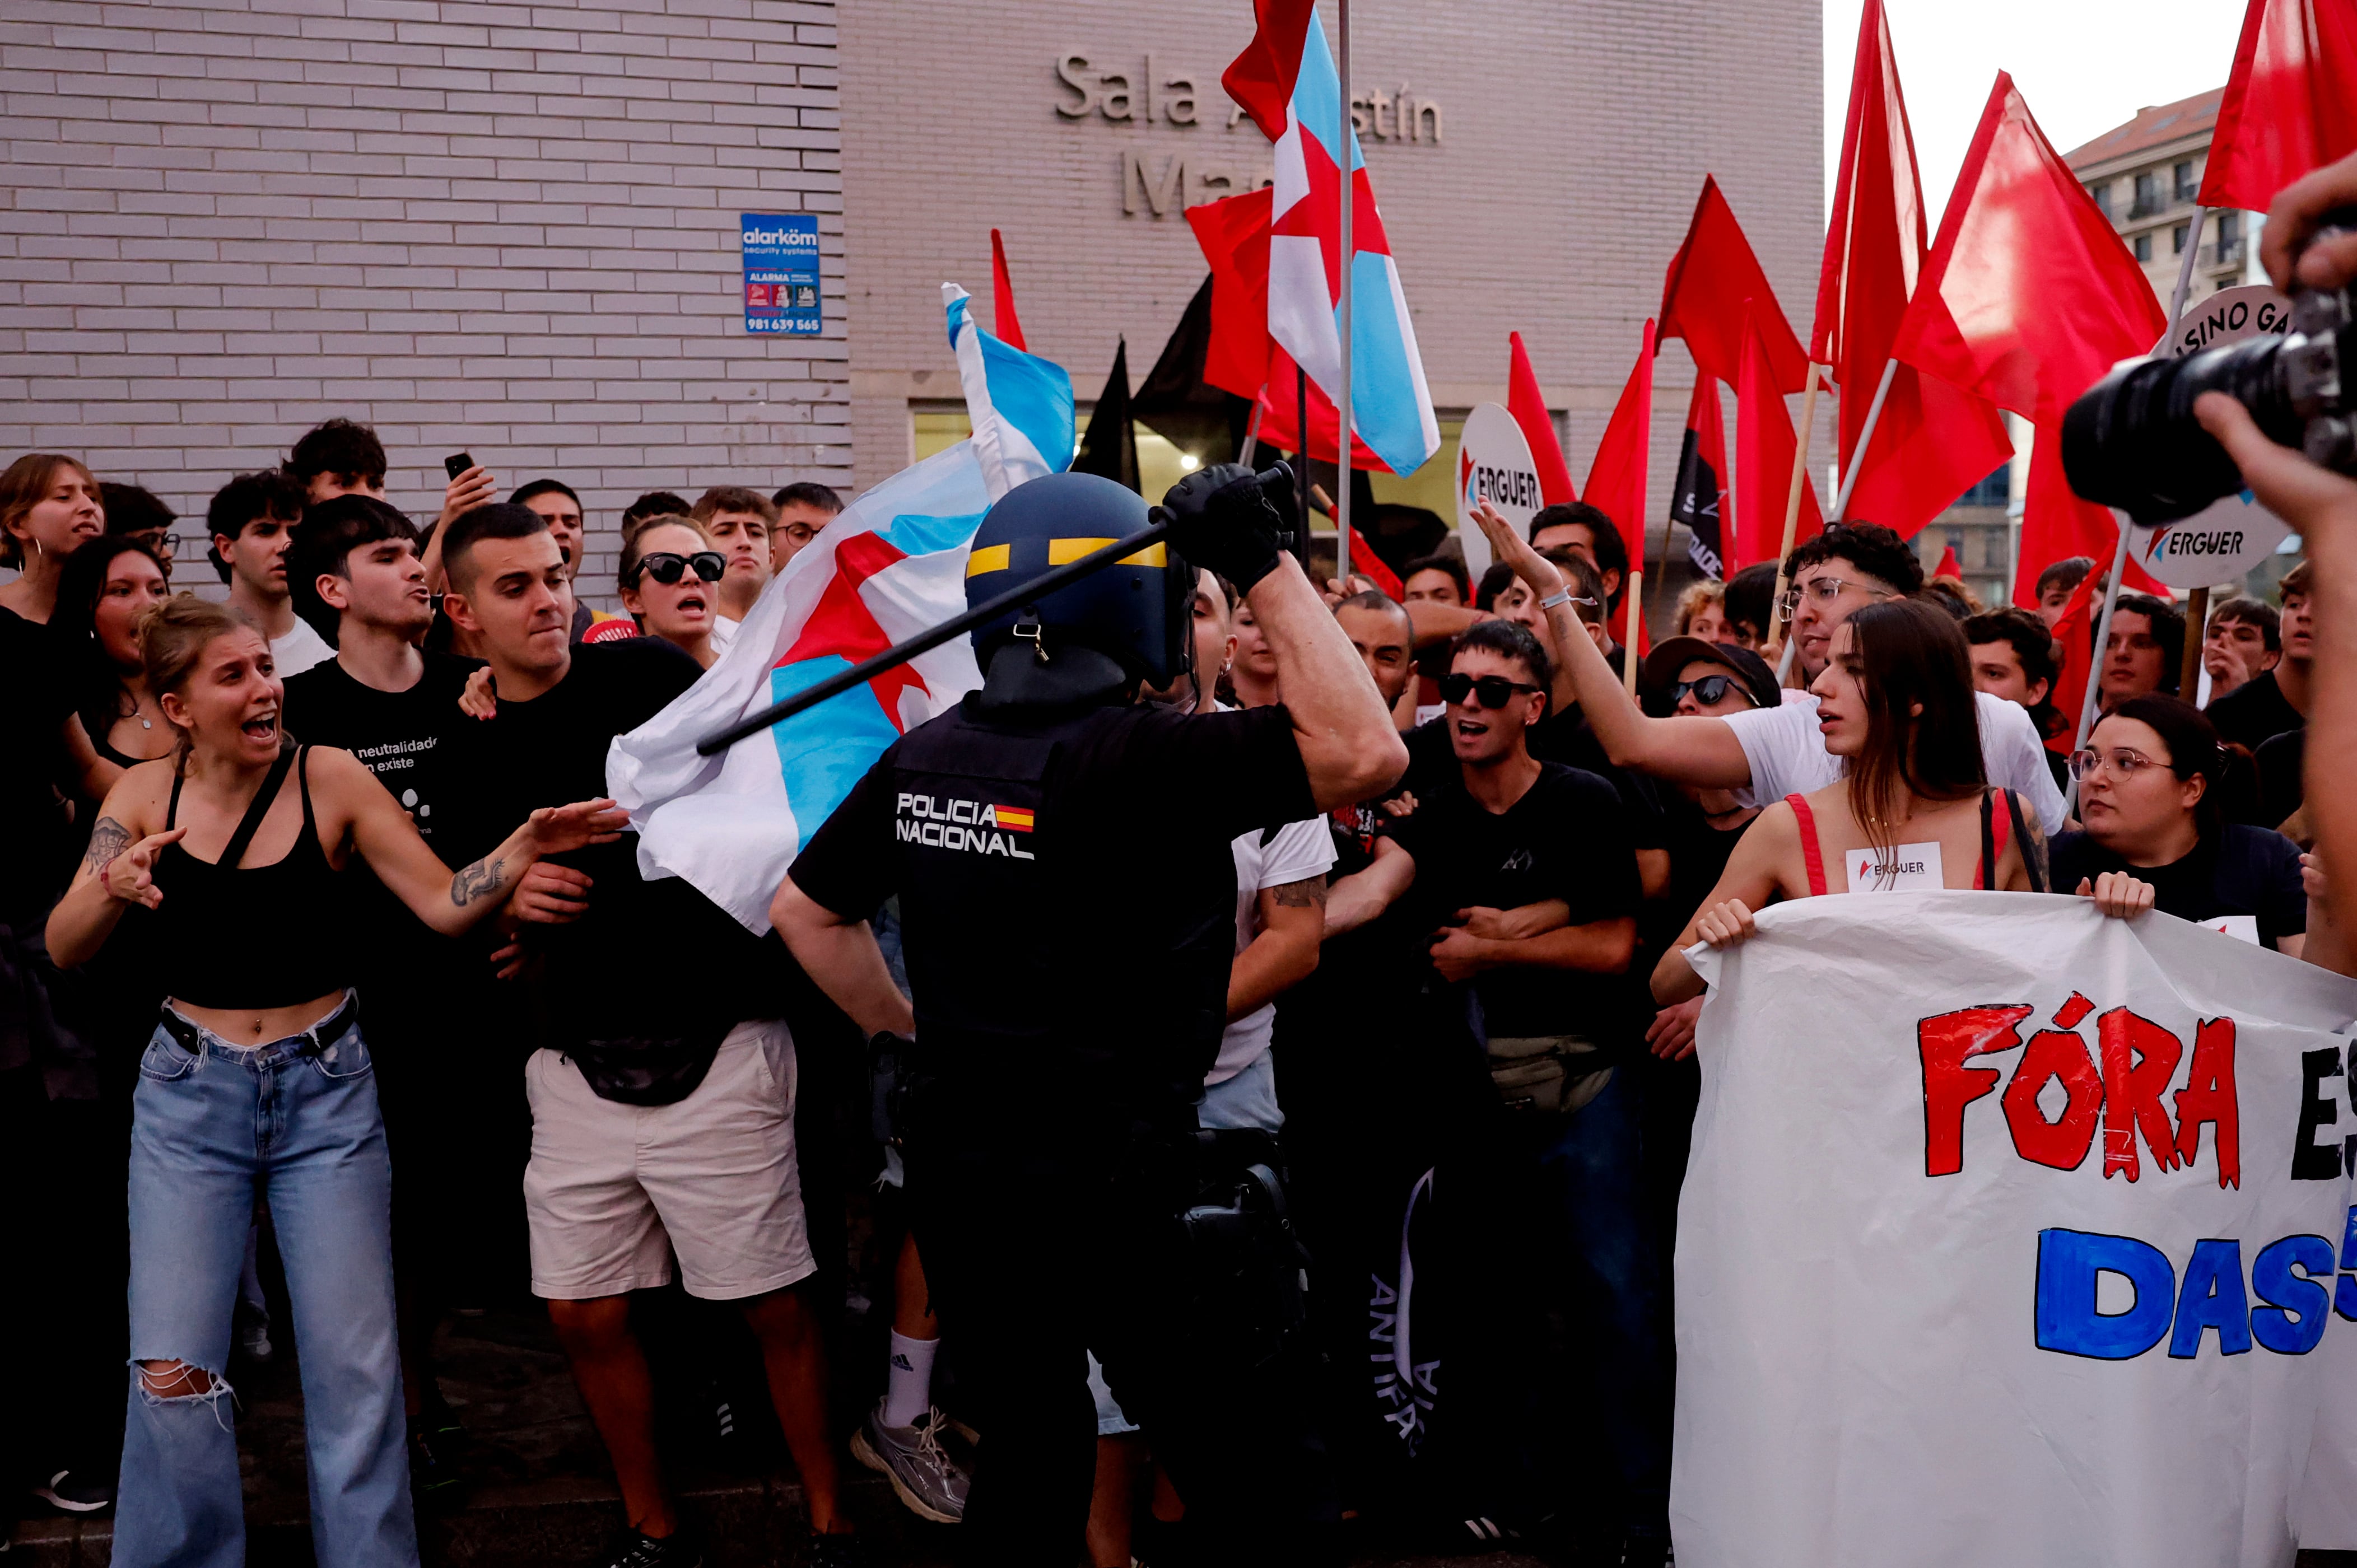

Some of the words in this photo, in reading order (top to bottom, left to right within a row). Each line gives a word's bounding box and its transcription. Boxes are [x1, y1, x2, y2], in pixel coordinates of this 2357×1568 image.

[1056, 52, 1199, 124] Sala
[743, 227, 817, 246] alarköm
[749, 273, 790, 282] ALARMA
[748, 318, 770, 330] 981
[771, 319, 794, 330] 639
[2176, 301, 2248, 357] SINO
[1478, 466, 1539, 510] ERGUER
[2169, 531, 2243, 556] ERGUER
[377, 757, 414, 772] existe
[896, 818, 1035, 860] NACIONAL
[1874, 862, 1925, 875] ERGUER
[1918, 990, 2240, 1191] FÓRA
